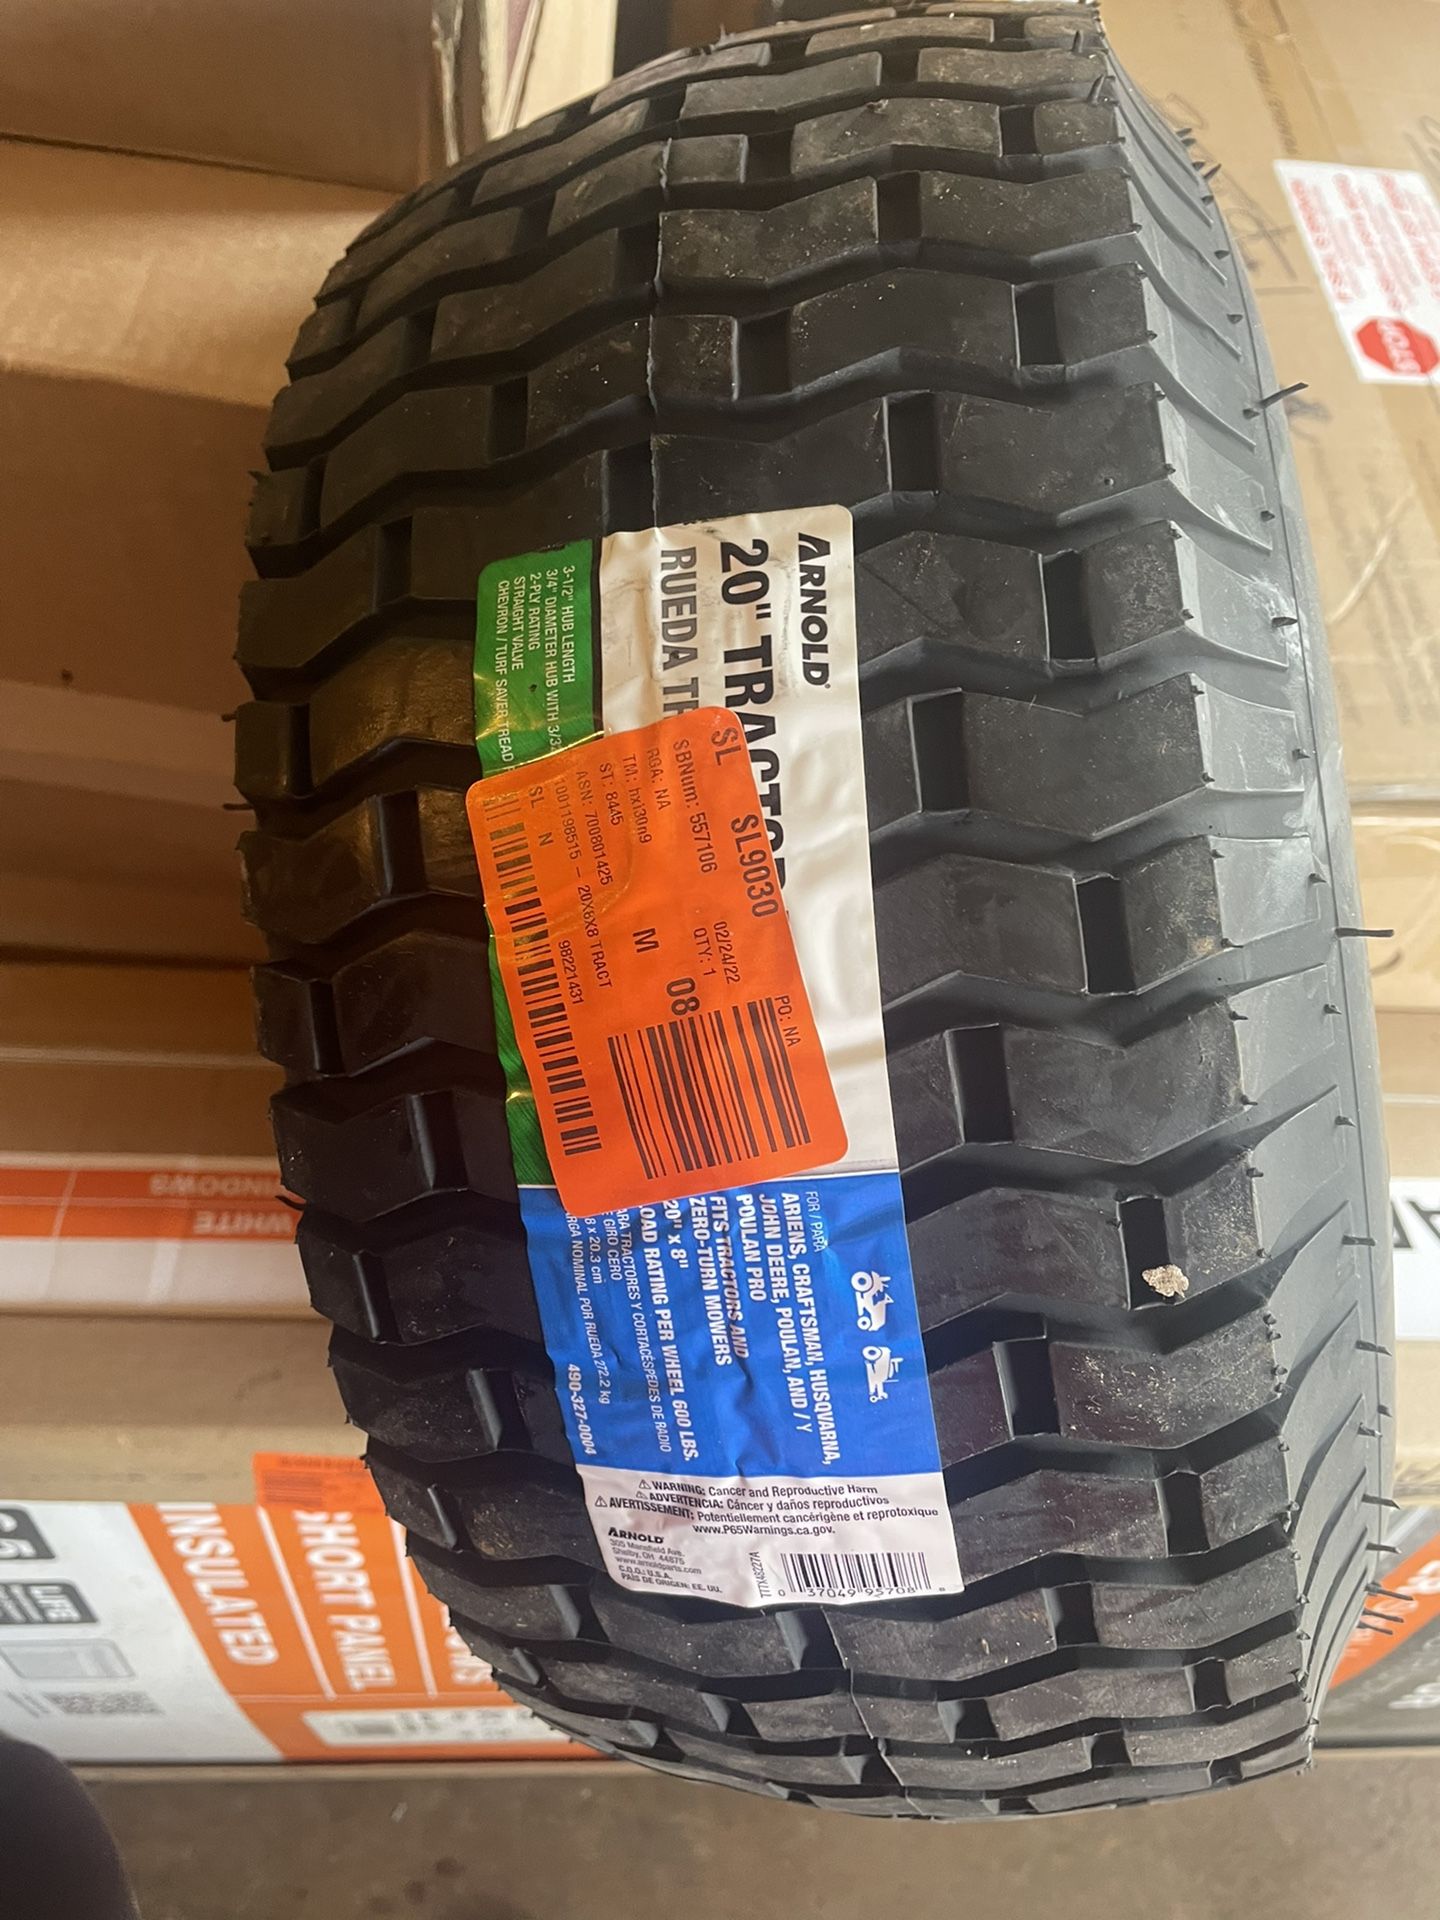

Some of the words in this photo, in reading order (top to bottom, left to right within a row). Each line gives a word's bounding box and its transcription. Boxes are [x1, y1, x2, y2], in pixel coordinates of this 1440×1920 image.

[528, 572, 541, 603] 2-PLY
[546, 569, 558, 592] 3/4"
[562, 566, 574, 600] 3-1/2"
[720, 539, 772, 619] 20"
[496, 580, 509, 634] CHEVRON
[512, 576, 525, 630] STRAIGHT
[562, 606, 574, 630] HUB
[660, 547, 698, 671] RUEDA
[798, 533, 831, 686] ARNOLD
[528, 608, 540, 650] RATING
[545, 597, 557, 657] DIAMETER
[495, 644, 508, 675] TURF
[512, 635, 524, 670] VALVE
[562, 634, 574, 682] LENGTH
[545, 662, 558, 687] HUB
[496, 680, 508, 718] SAVER
[546, 690, 559, 721] WITH
[498, 722, 514, 762] TREAD
[711, 727, 742, 766] SL
[600, 763, 614, 786] ST:
[622, 754, 638, 782] TM:
[647, 748, 664, 783] RGA:
[528, 786, 544, 808] SL
[538, 832, 554, 846] N
[606, 792, 624, 826] 8445
[654, 789, 672, 810] NA
[674, 740, 699, 808] SBNum:
[690, 812, 718, 872] 557106
[576, 772, 592, 806] ASN:
[586, 812, 613, 885] 700801425
[730, 814, 779, 918] SL9030
[633, 928, 659, 952] M
[693, 928, 712, 963] QTY:
[713, 922, 740, 984] 02/24/22
[558, 940, 584, 1004] 98221431
[590, 940, 612, 988] TRACT
[702, 968, 717, 976] 1
[666, 978, 700, 1016] 08
[775, 995, 793, 1023] PO:
[784, 1026, 801, 1047] NA
[662, 1200, 682, 1229] 20"
[710, 1196, 730, 1232] FITS
[758, 1194, 782, 1238] JOHN
[806, 1191, 820, 1211] FOR
[604, 1219, 618, 1244] GIRO
[668, 1234, 682, 1244] x
[782, 1192, 806, 1260] ARIENS,
[588, 1237, 600, 1262] 20.3
[607, 1250, 622, 1280] CERO
[670, 1249, 688, 1268] 8"
[736, 1194, 758, 1263] POULAN
[747, 1267, 766, 1301] PRO
[570, 1240, 586, 1294] NOMINAL
[591, 1266, 602, 1283] cm
[620, 1232, 640, 1300] TRACTORES
[643, 1248, 668, 1304] RATING
[689, 1198, 719, 1291] ZERO-TURN
[706, 1295, 732, 1366] MOWERS
[715, 1236, 744, 1320] TRACTORS
[766, 1244, 794, 1304] DEERE,
[578, 1297, 594, 1319] POR
[632, 1302, 643, 1310] Y
[792, 1264, 823, 1366] CRAFTSMAN,
[584, 1322, 601, 1358] RUEDA
[656, 1310, 674, 1340] PER
[730, 1325, 749, 1358] AND
[776, 1308, 802, 1373] POULAN,
[594, 1360, 610, 1386] 272.2
[632, 1312, 661, 1402] CORTACÉSPEDES
[662, 1345, 686, 1396] WHEEL
[567, 1364, 597, 1454] 490-327-0004
[598, 1391, 611, 1404] kg
[786, 1377, 808, 1408] AND
[651, 1406, 664, 1418] DE
[672, 1400, 692, 1428] 600
[796, 1424, 812, 1432] Y
[809, 1370, 840, 1465] HUSQVARNA,
[654, 1422, 672, 1452] RADIO
[678, 1431, 699, 1462] LBS.
[650, 1493, 724, 1509] ADVERTENCIA:
[727, 1500, 764, 1511] Cáncer
[767, 1501, 774, 1512] y
[776, 1498, 810, 1511] daños
[813, 1495, 890, 1510] reproductivos
[652, 1481, 706, 1496] WARNING:
[709, 1486, 746, 1497] Cancer
[748, 1486, 769, 1497] and
[772, 1485, 845, 1499] Reproductive
[849, 1484, 878, 1494] Harm
[610, 1497, 694, 1520] AVERTISSEMENT:
[697, 1511, 780, 1524] Potentiellement
[783, 1508, 850, 1523] cancérigène
[853, 1510, 864, 1521] et
[867, 1507, 939, 1521] reprotoxique
[608, 1527, 664, 1544] ARNOLD
[692, 1523, 836, 1537] www.P65Warnings.ca.gov.
[157, 1502, 279, 1664] INSULATED
[643, 1575, 655, 1585] DE
[778, 1589, 786, 1597] 0
[808, 1586, 857, 1598] 37049
[328, 1614, 396, 1690] PANEL
